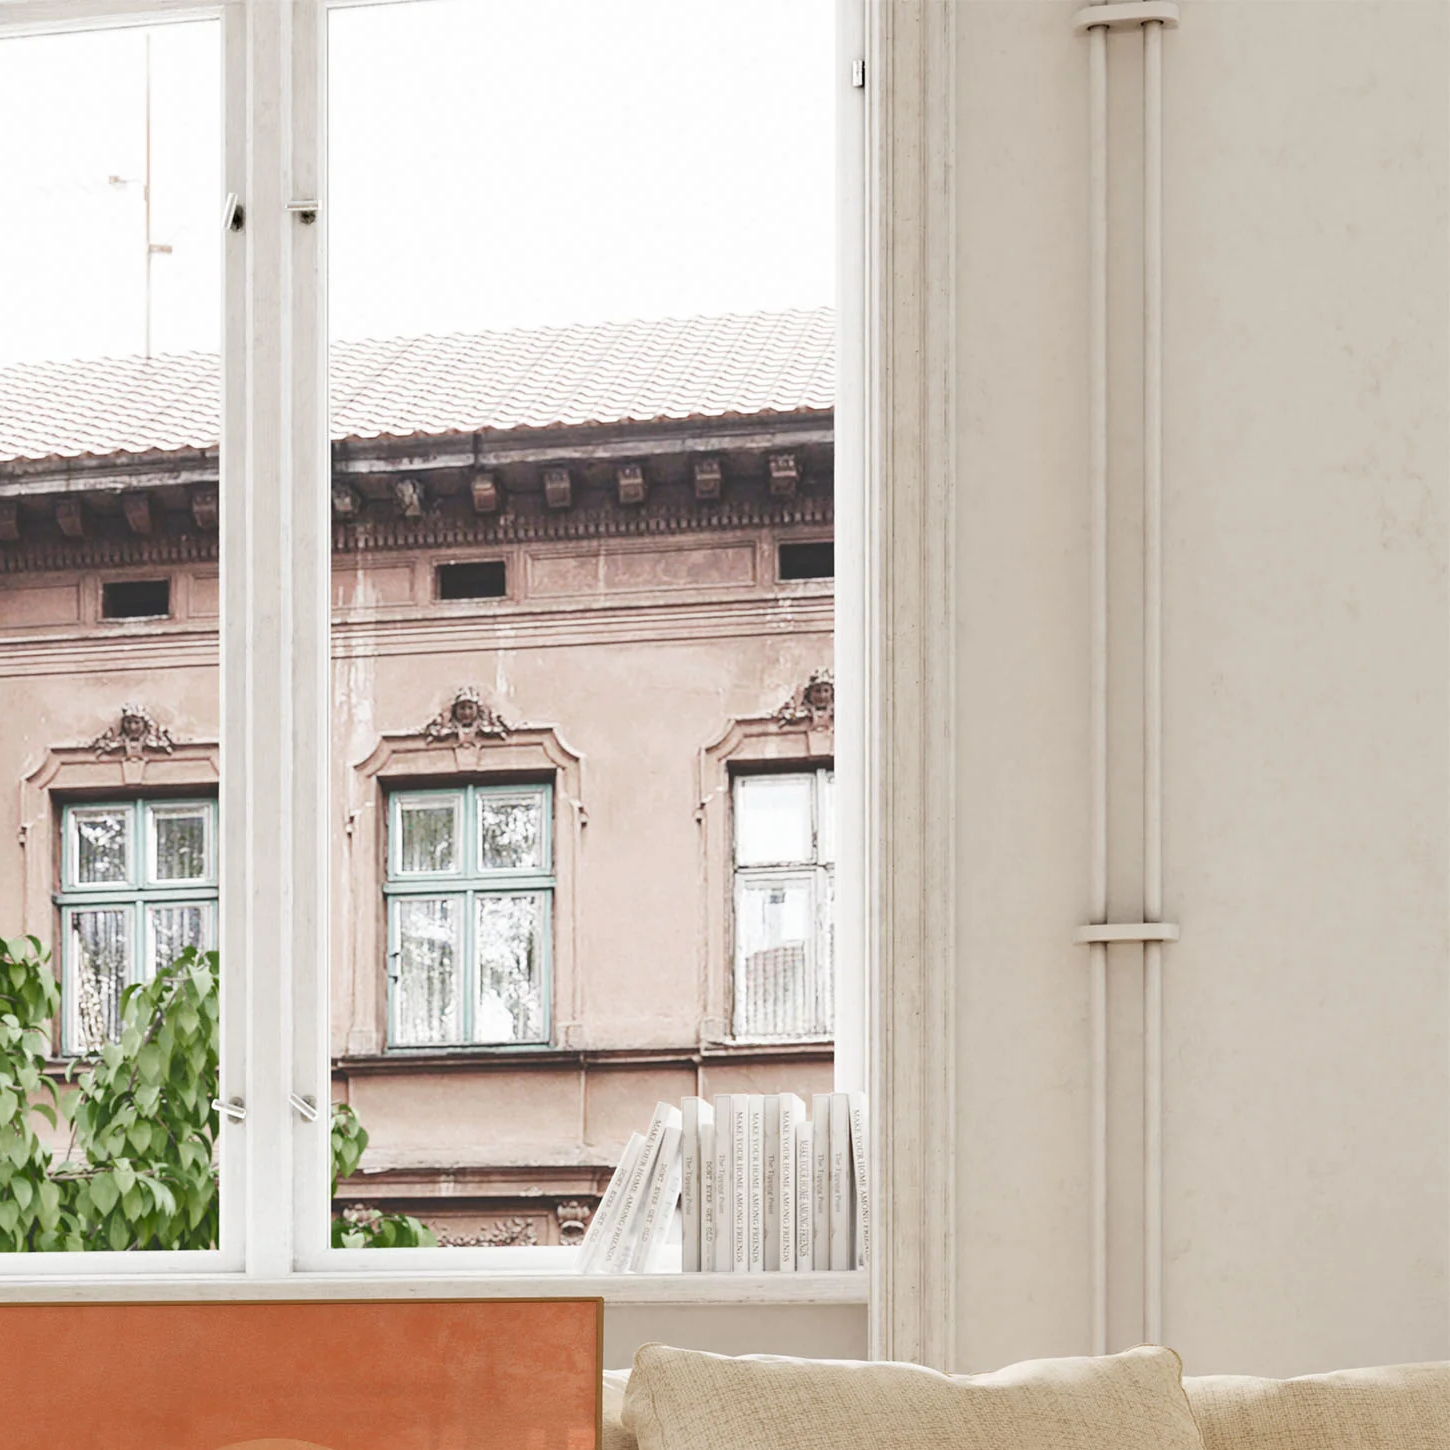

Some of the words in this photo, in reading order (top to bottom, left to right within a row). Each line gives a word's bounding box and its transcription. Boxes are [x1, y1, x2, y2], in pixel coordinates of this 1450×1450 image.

[648, 1119, 663, 1142] MAKE
[782, 1110, 790, 1135] MAKE
[853, 1109, 861, 1133] MAKE
[638, 1144, 655, 1167] YOUR
[782, 1136, 790, 1162] YOUR
[854, 1136, 863, 1160] YOUR
[629, 1168, 644, 1194] HOME
[782, 1163, 790, 1189] HOME
[857, 1161, 867, 1188] HOME
[617, 1195, 634, 1226] AMONG
[646, 1209, 655, 1224] GET
[782, 1191, 790, 1224] AMONG
[605, 1227, 622, 1262] FRIENDS
[782, 1226, 790, 1263] FRIENDS
